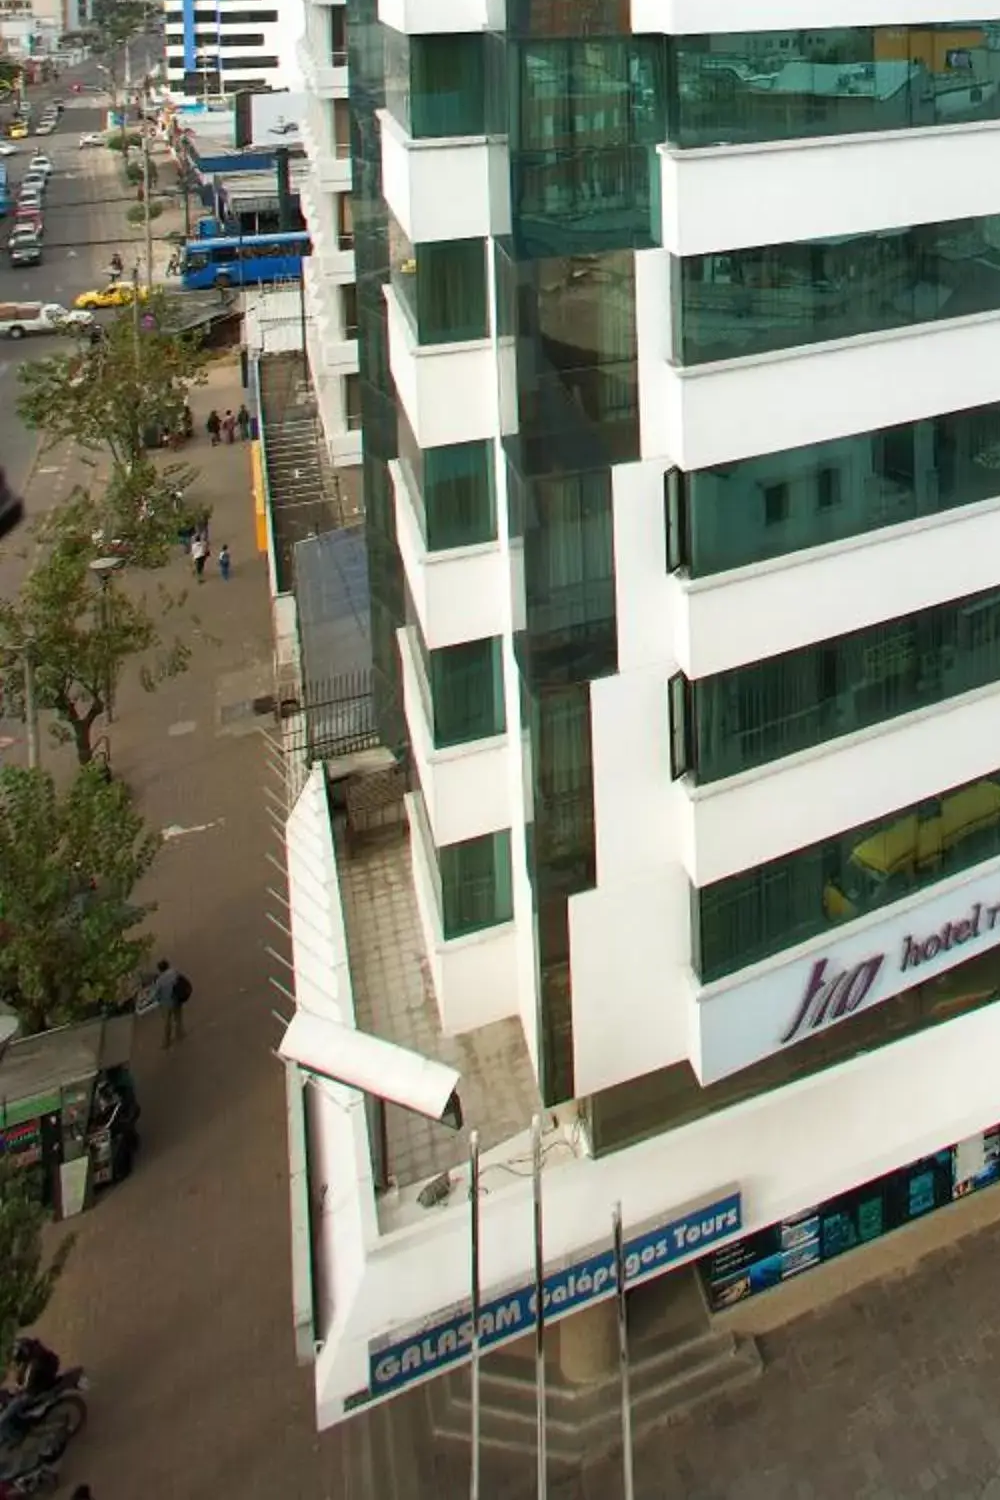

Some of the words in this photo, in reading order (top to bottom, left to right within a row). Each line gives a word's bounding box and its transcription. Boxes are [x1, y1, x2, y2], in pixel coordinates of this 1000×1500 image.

[900, 903, 981, 972] hotel
[375, 1300, 521, 1382] GALASAM
[673, 1207, 737, 1248] Tours
